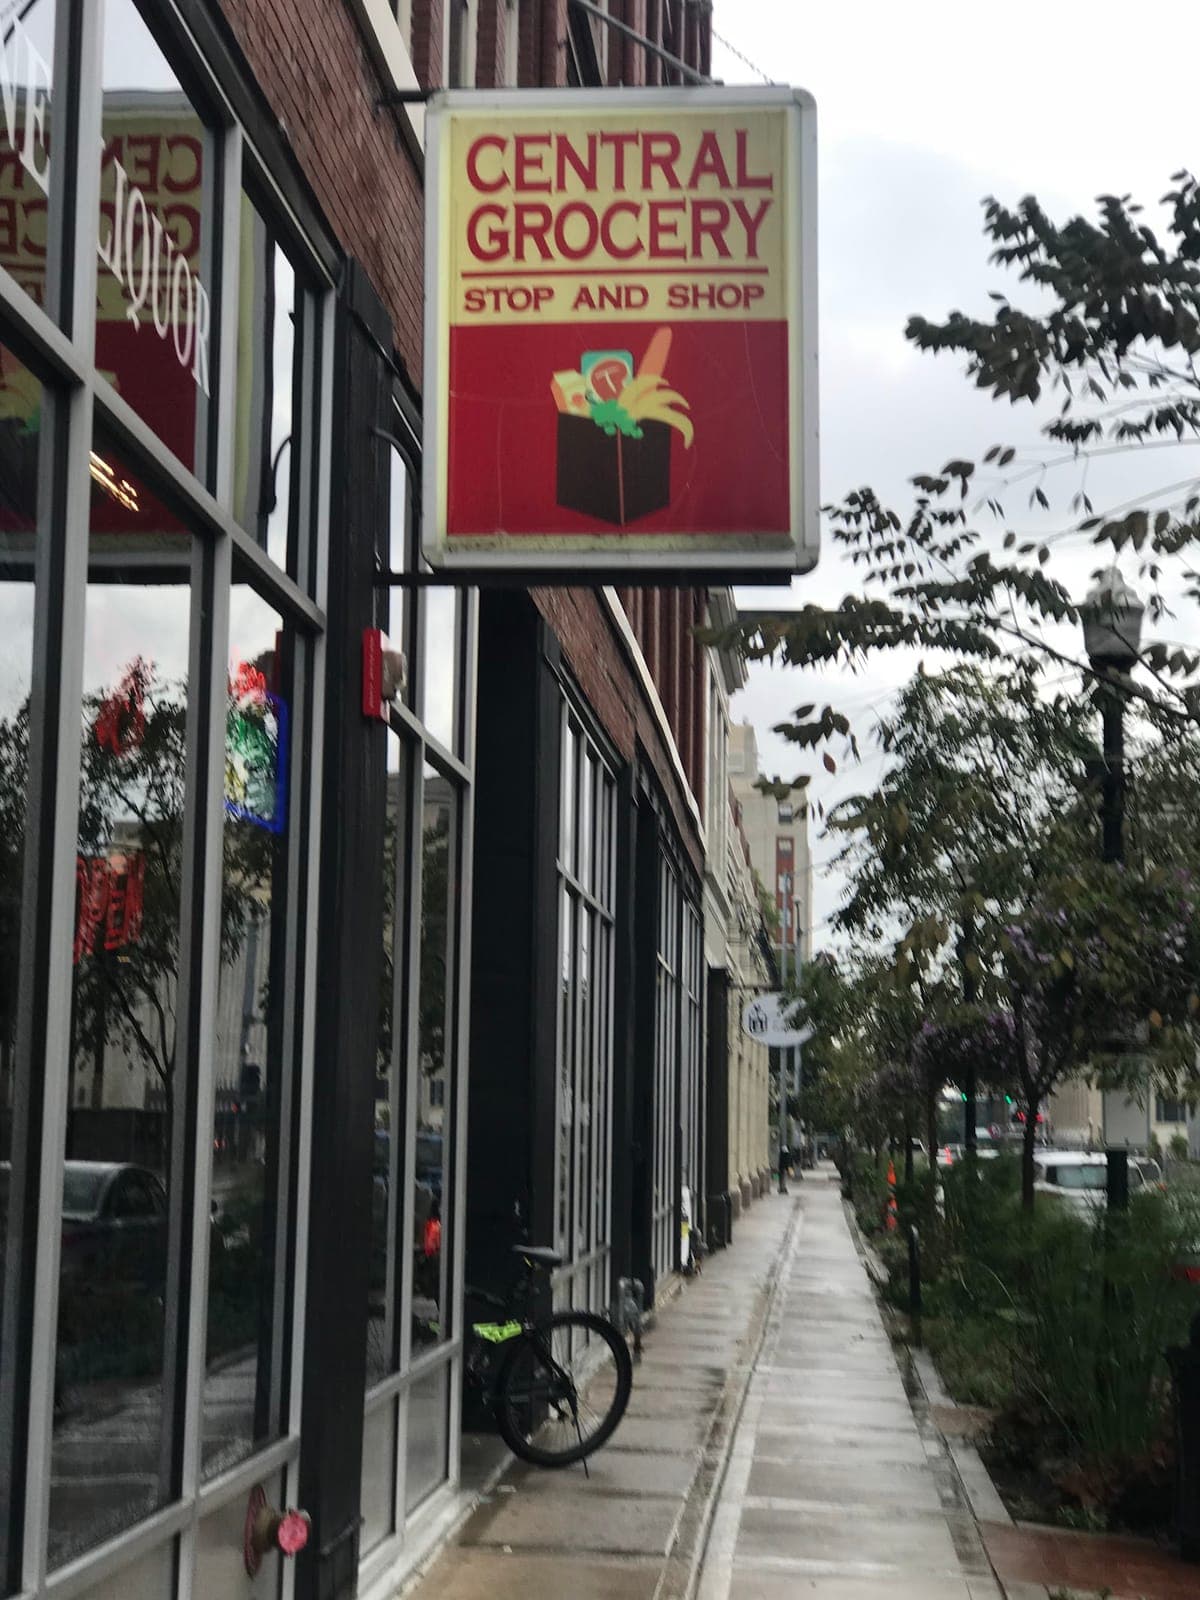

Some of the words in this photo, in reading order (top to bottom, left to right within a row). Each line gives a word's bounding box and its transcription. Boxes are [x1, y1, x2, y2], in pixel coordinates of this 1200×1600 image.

[466, 129, 774, 194] CENTRAL
[467, 197, 773, 262] GROCERY
[97, 134, 210, 398] IQUOR
[464, 286, 555, 312] STOP
[572, 285, 650, 310] AND
[667, 283, 766, 309] SHOP
